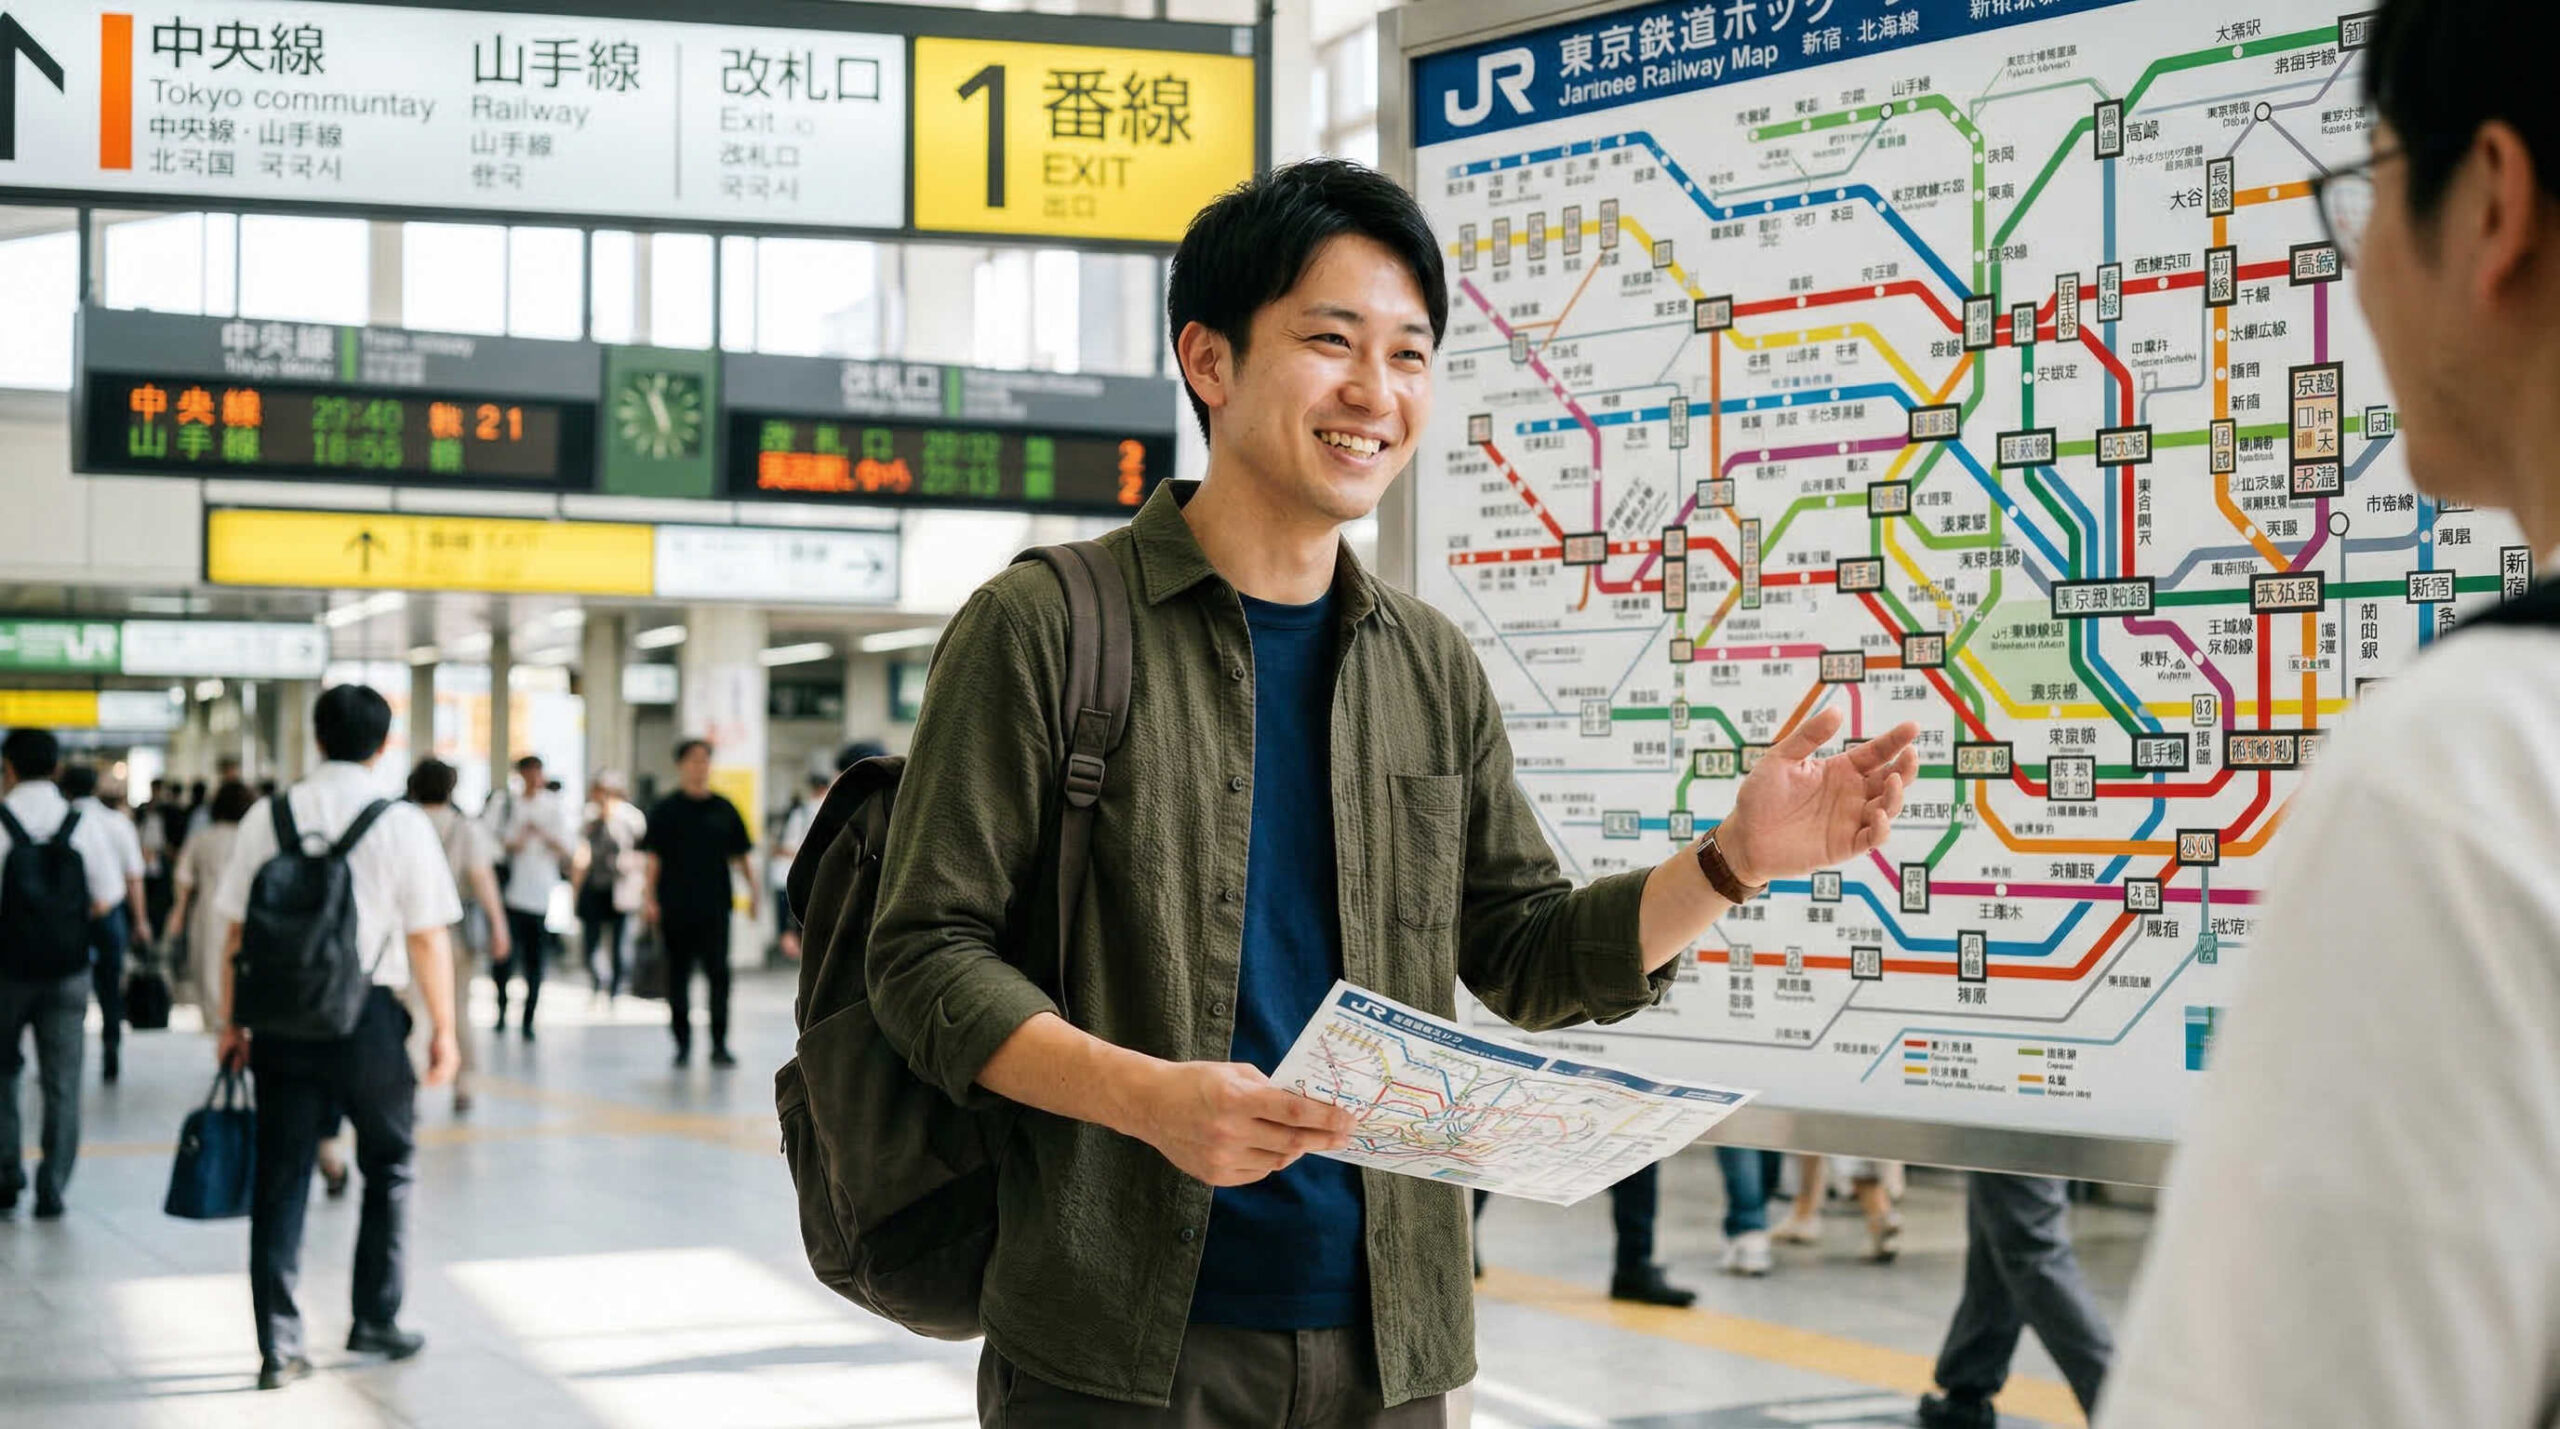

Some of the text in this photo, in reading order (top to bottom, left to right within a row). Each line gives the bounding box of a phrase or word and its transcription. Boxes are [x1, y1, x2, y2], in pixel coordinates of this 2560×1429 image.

[152, 15, 325, 76] 中央線
[474, 34, 641, 93] 山手線
[1643, 55, 1726, 88] Railway
[1732, 44, 1779, 71] Map
[150, 78, 242, 114] Tokyo
[720, 48, 881, 104] 改札口
[1444, 46, 1536, 128] JR
[472, 95, 590, 129] Railway
[720, 107, 775, 135] Exit
[957, 65, 1193, 208] 1 番線
[1043, 153, 1133, 188] EXIT
[475, 403, 524, 442] 21
[1350, 999, 1388, 1021] JR
